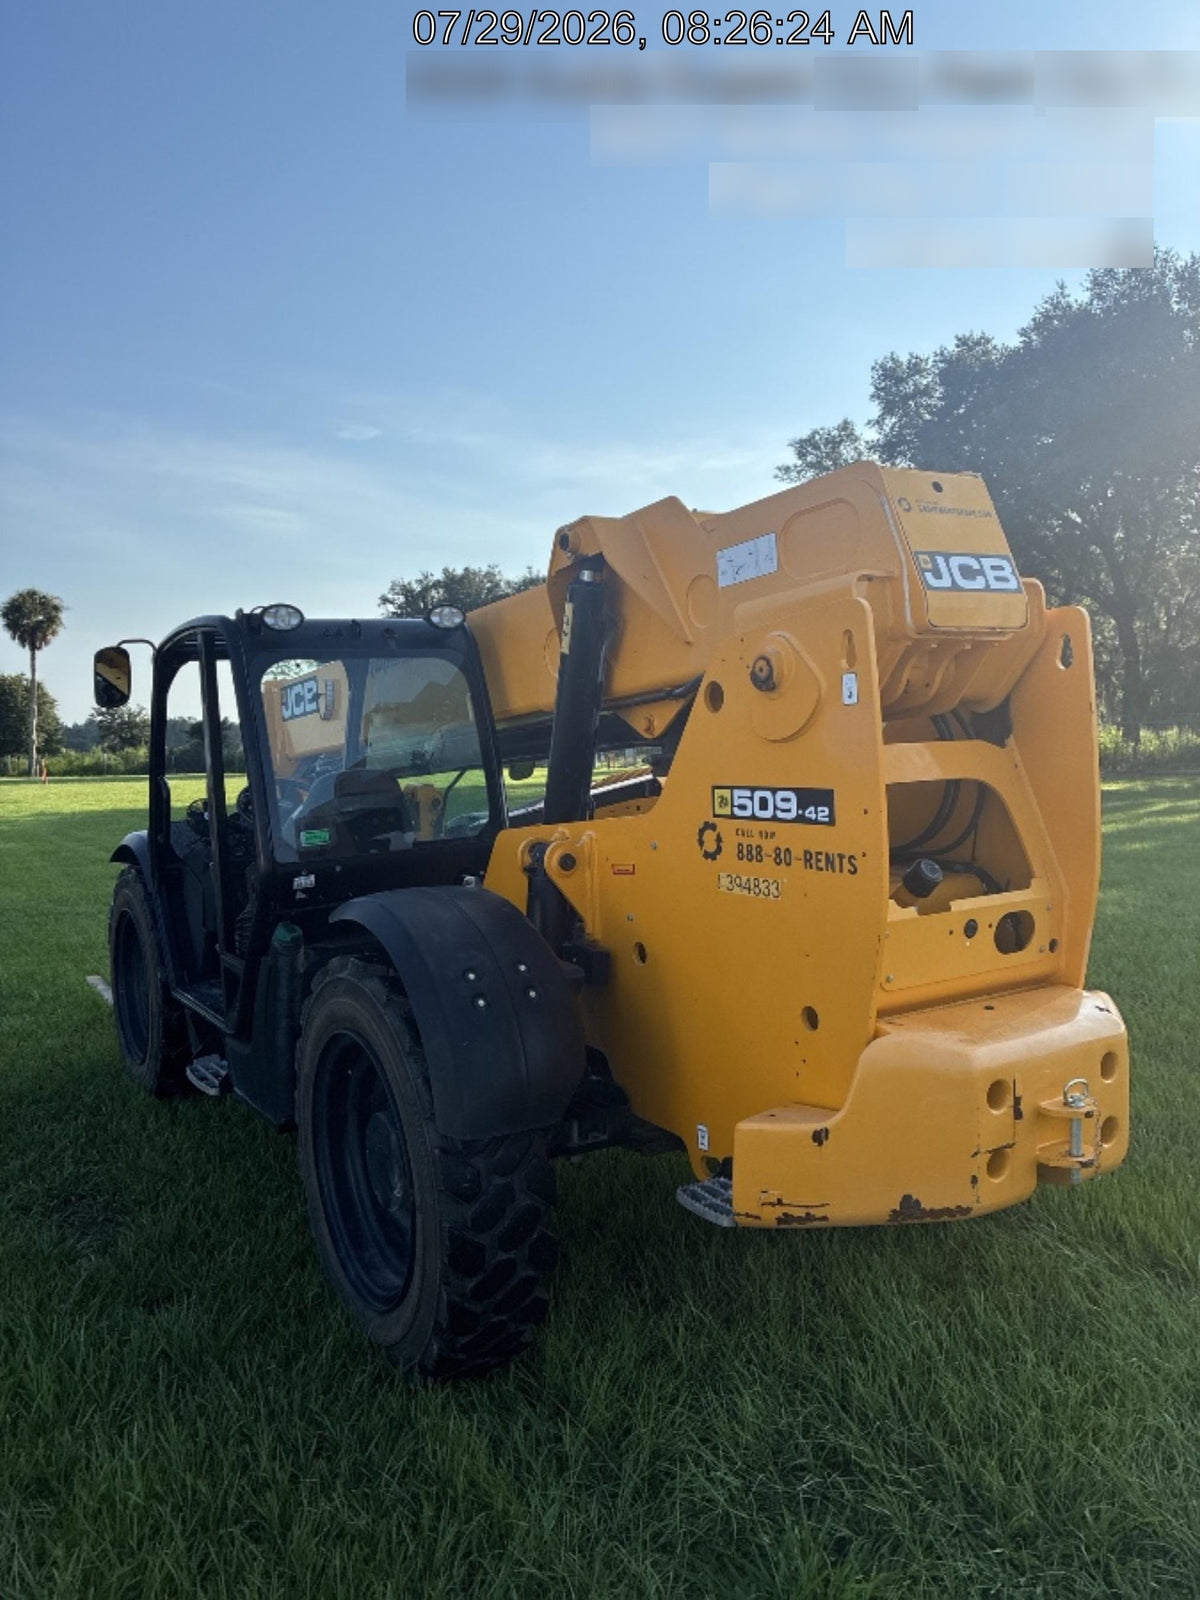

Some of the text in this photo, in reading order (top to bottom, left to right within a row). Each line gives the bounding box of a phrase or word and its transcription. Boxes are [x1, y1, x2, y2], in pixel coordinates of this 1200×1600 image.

[924, 556, 1018, 589] JCB
[283, 681, 317, 719] JCB
[738, 843, 857, 875] 888-80-RENTS
